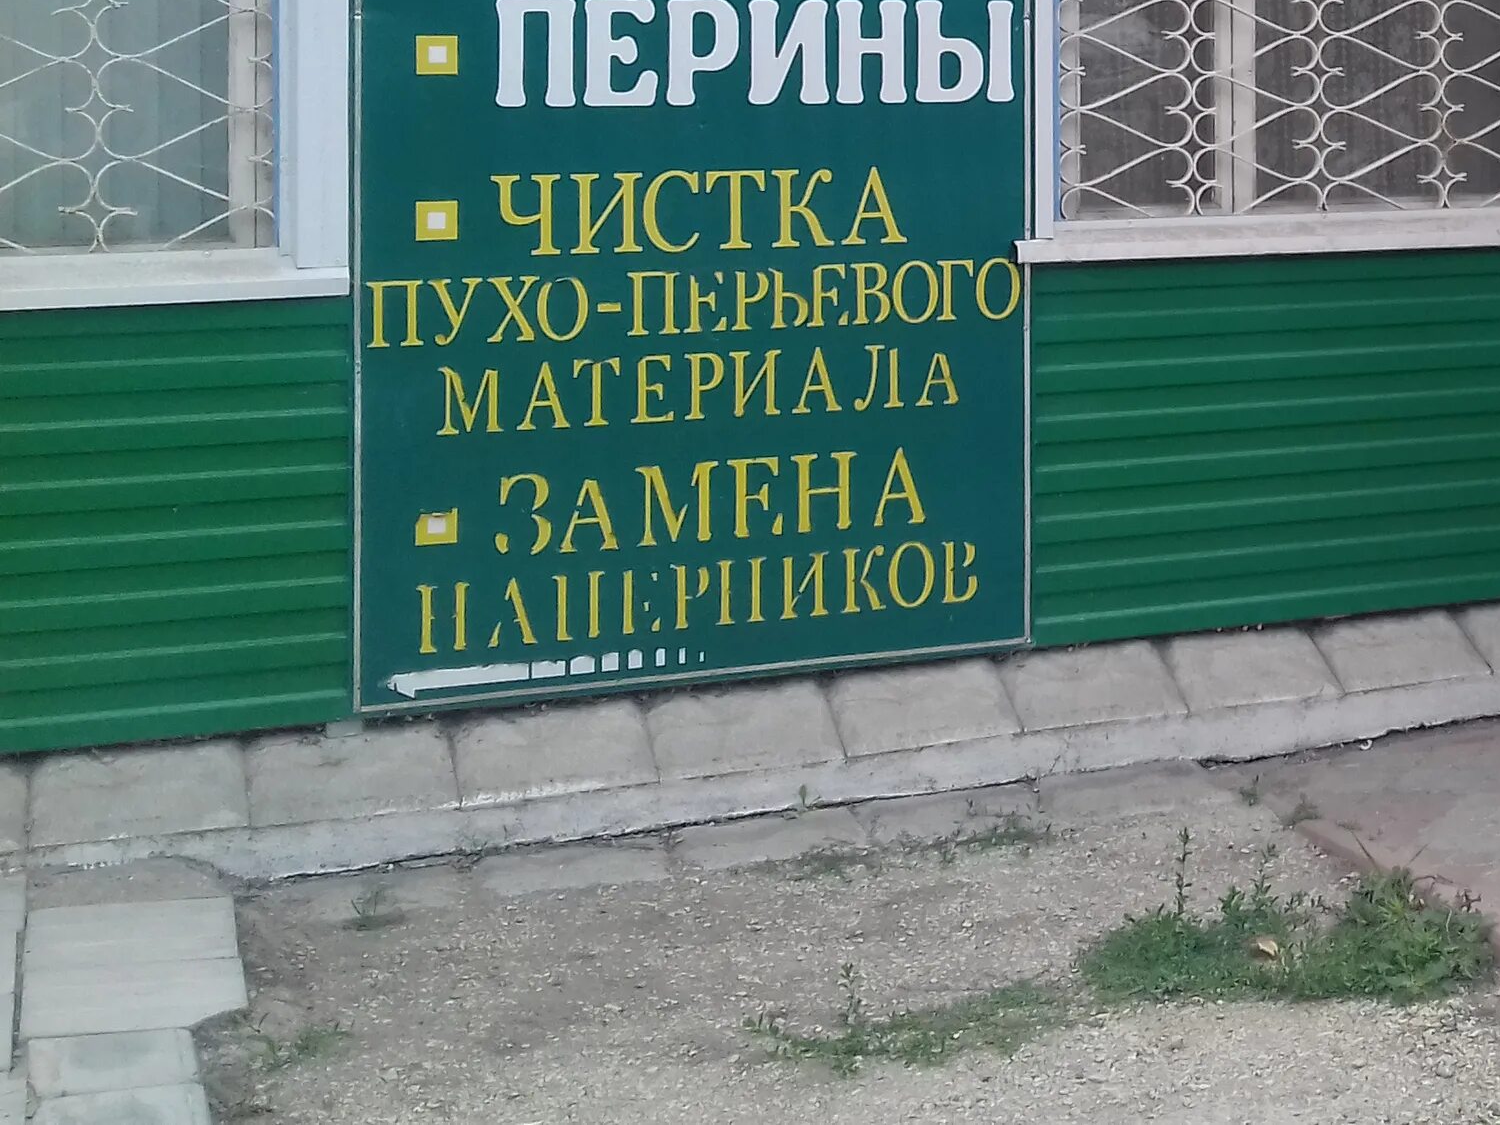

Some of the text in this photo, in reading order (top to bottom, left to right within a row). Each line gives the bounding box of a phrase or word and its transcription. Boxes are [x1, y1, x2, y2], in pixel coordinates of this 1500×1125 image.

[490, 166, 908, 256] ЧИСТКА
[366, 256, 1022, 350] ПУХО-ПЕРЬЕВОГО
[435, 343, 960, 437] МАТЕРИАЛА
[493, 446, 926, 556] ЗАМЕНА
